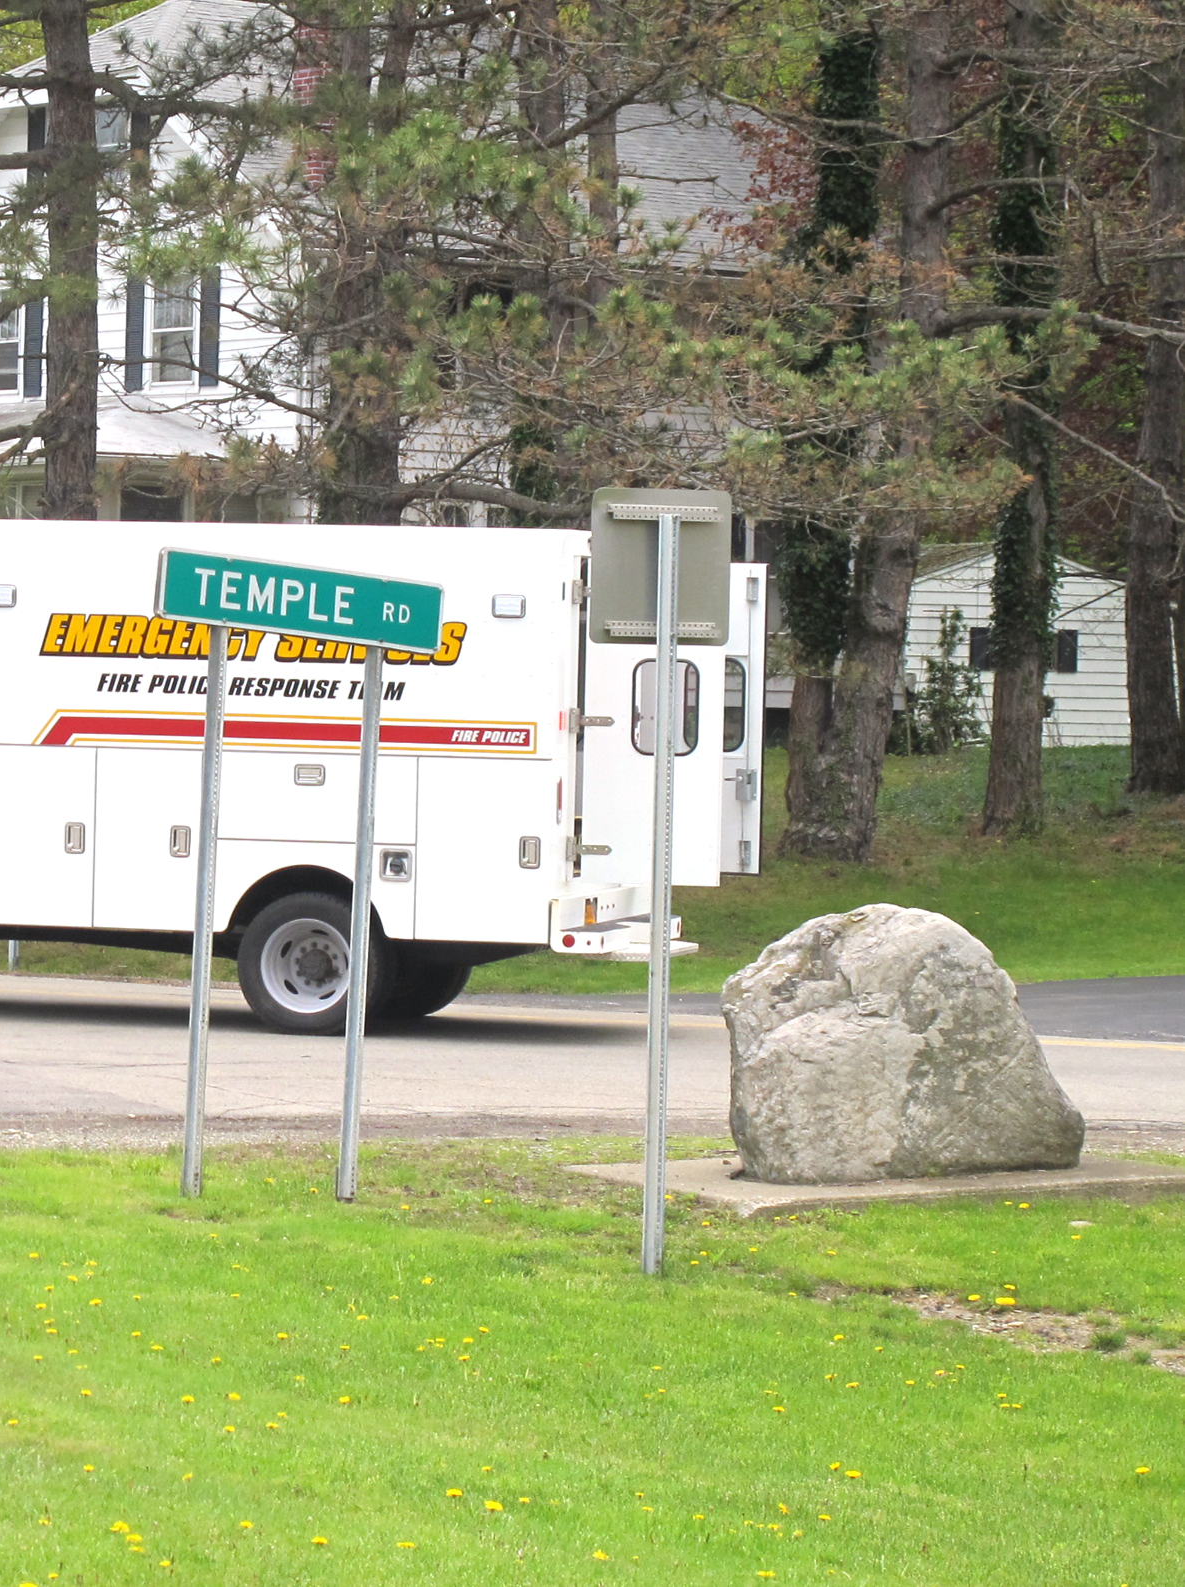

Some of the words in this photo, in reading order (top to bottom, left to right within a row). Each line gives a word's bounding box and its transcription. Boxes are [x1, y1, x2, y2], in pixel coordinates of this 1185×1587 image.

[194, 567, 355, 625] TEMPLE
[382, 602, 411, 624] RD
[97, 673, 143, 693] FIRE
[148, 675, 209, 695] POLIC
[228, 676, 342, 699] RESPONSE
[451, 729, 480, 743] FIRE
[481, 730, 528, 744] POLICE
